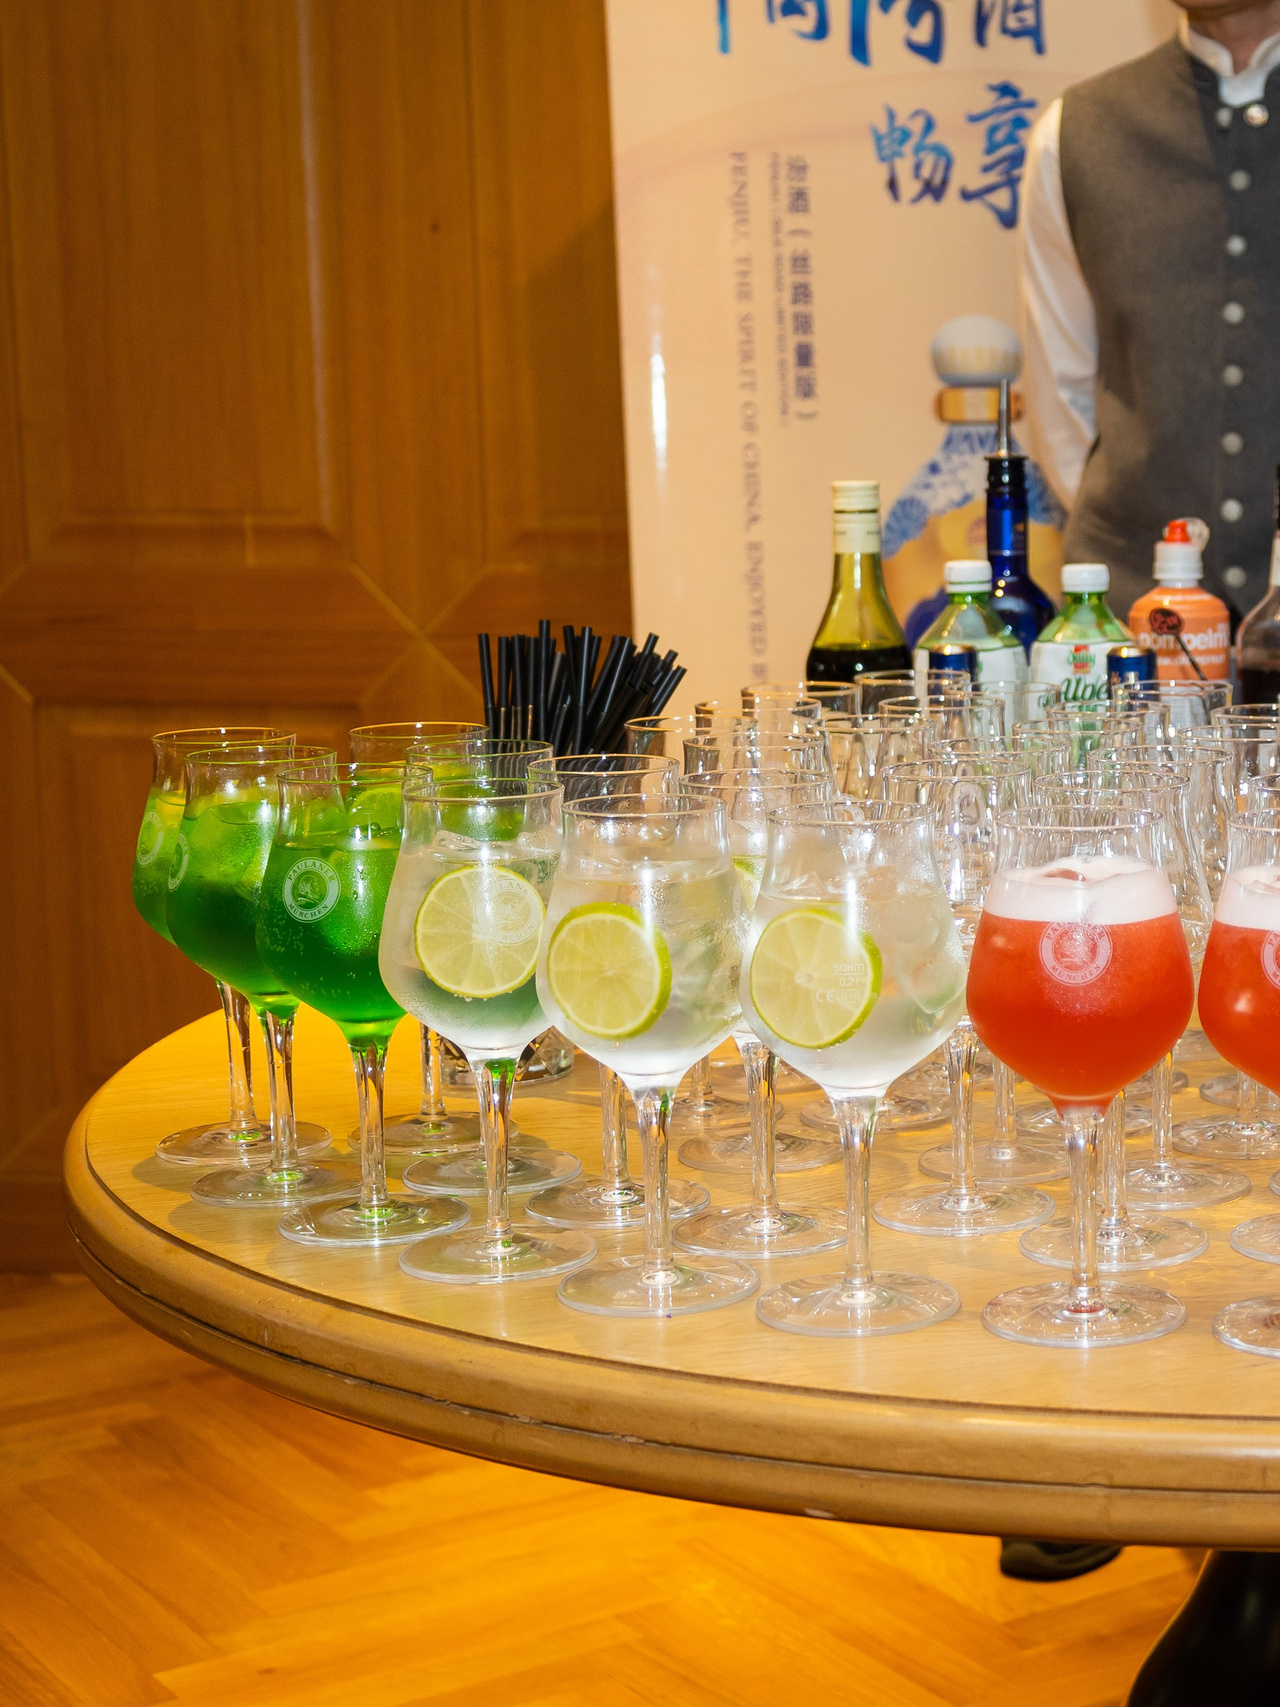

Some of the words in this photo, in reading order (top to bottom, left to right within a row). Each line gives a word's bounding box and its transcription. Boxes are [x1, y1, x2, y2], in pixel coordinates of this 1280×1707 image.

[869, 80, 1038, 230] 畅享
[735, 256, 753, 301] THE
[287, 861, 336, 883] PAULANER
